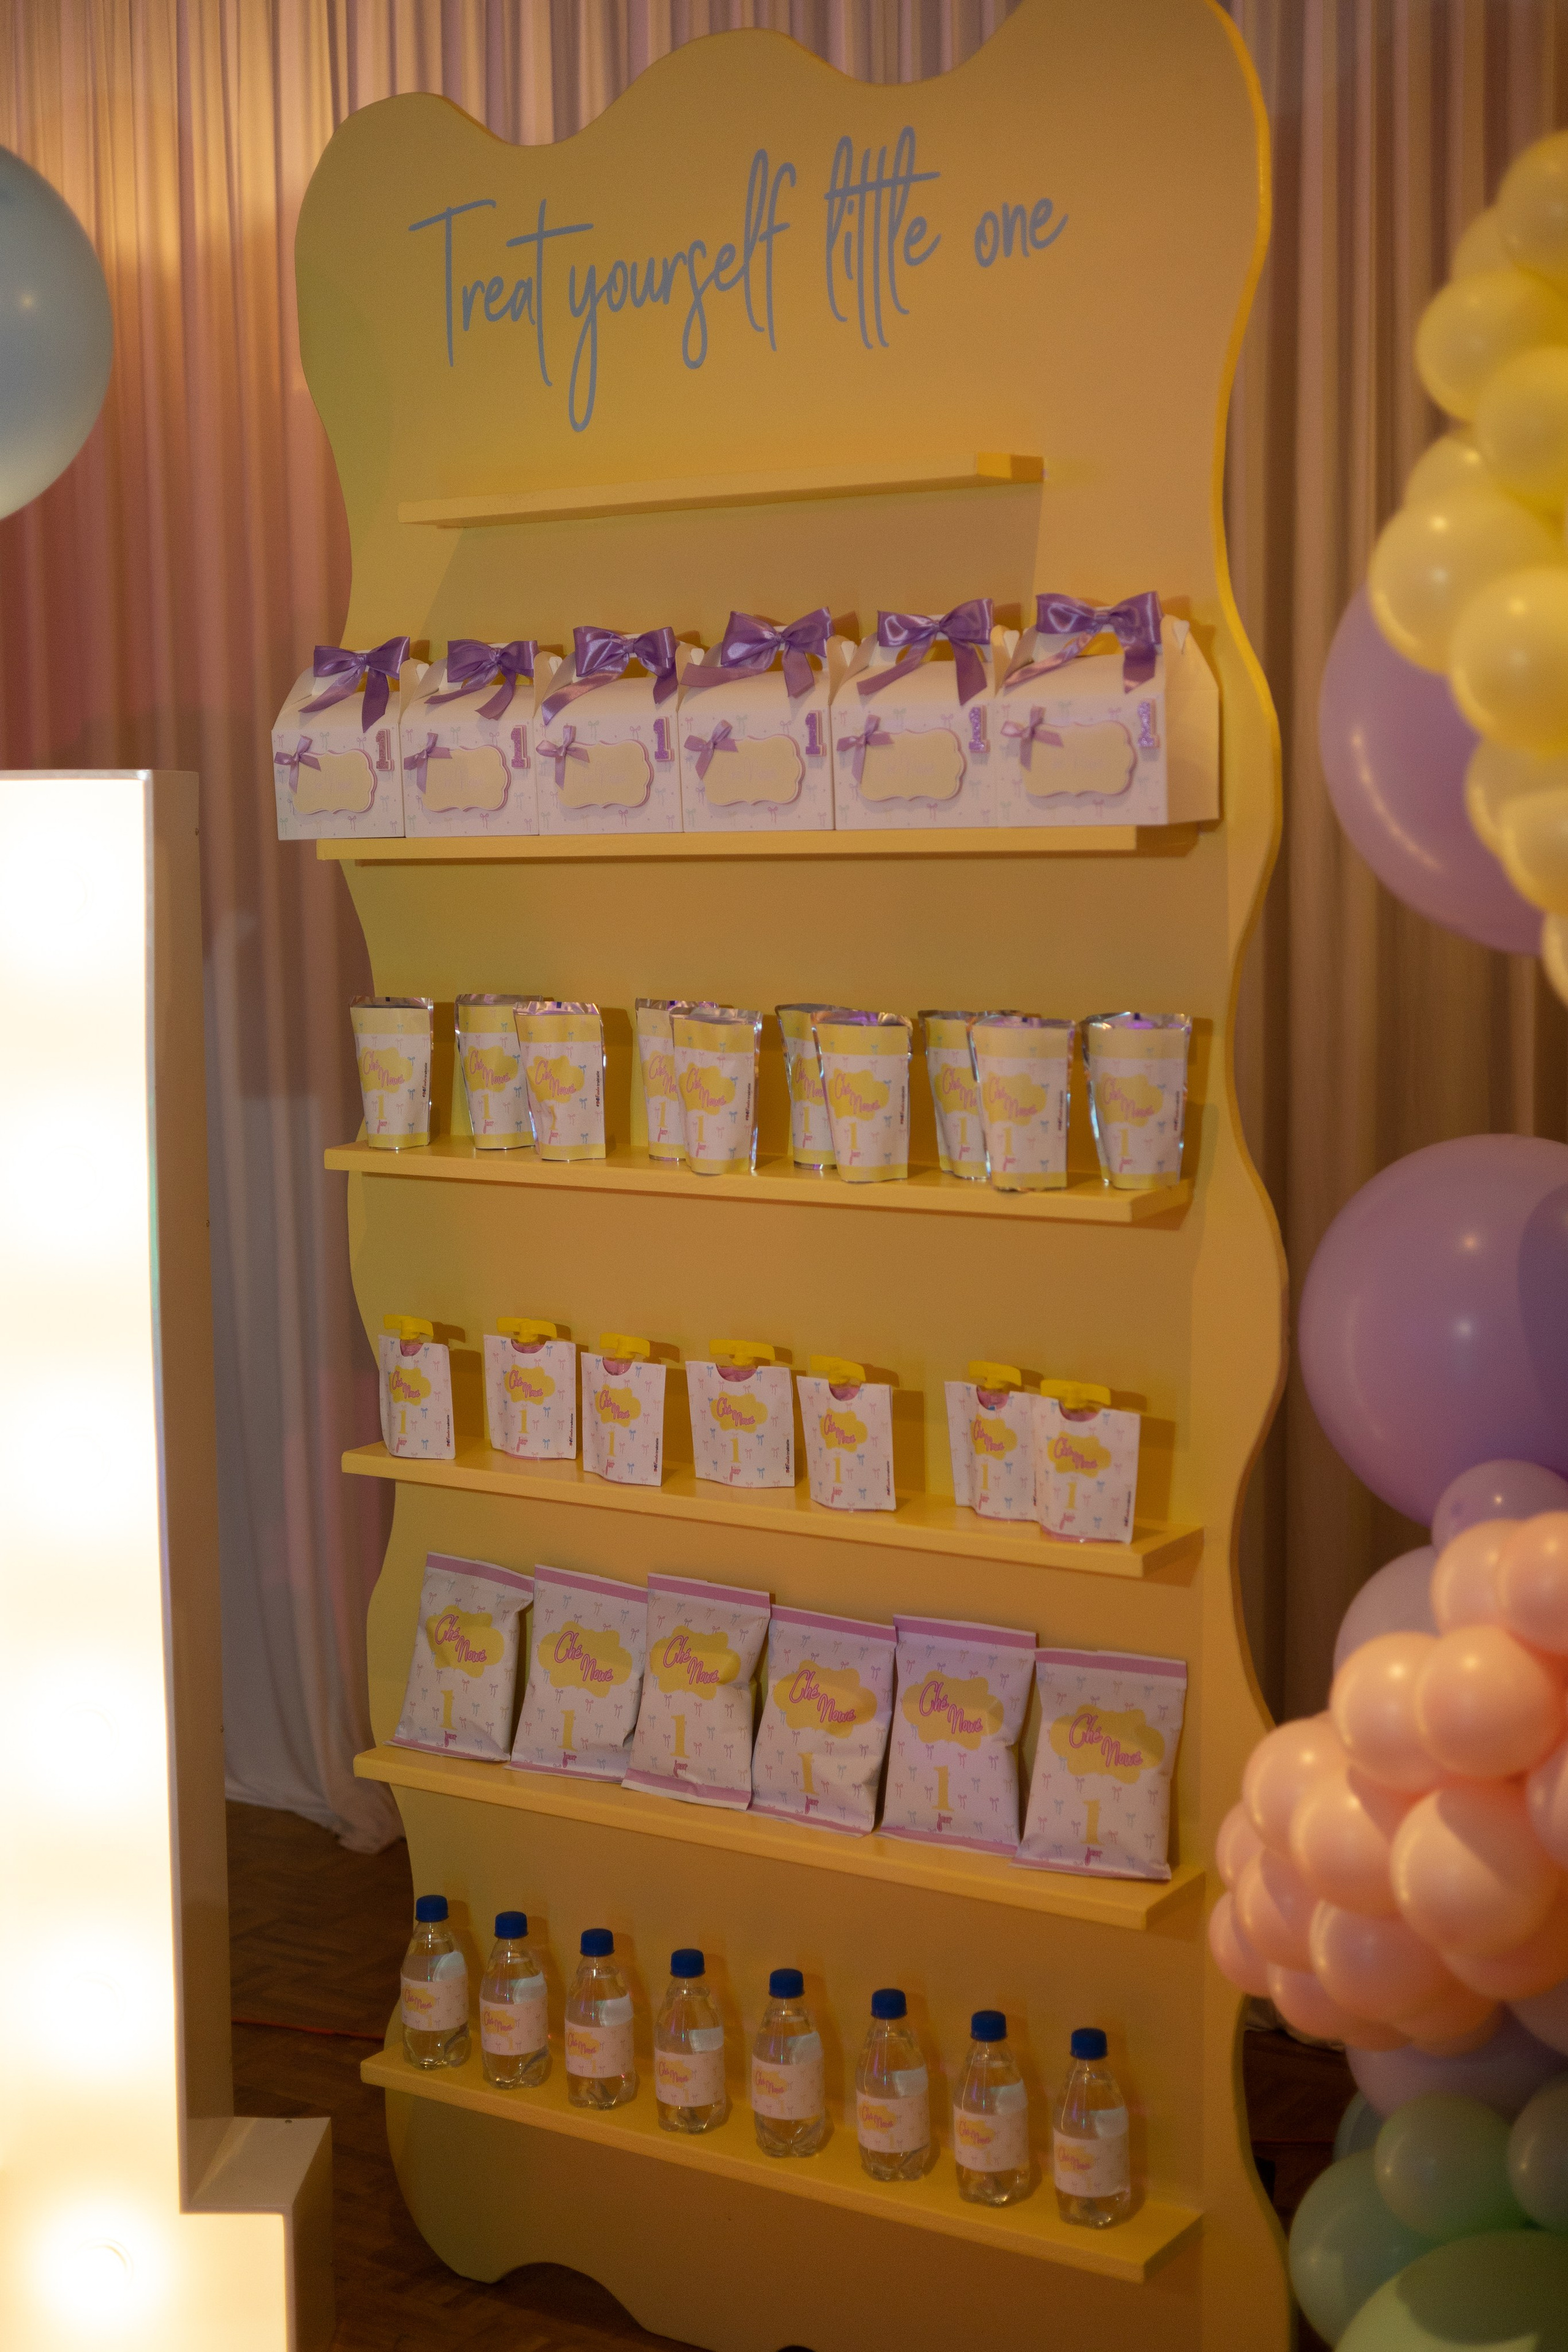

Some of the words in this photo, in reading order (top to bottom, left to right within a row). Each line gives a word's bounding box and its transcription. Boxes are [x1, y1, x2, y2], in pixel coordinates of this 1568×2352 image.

[408, 198, 594, 386] Treat
[568, 148, 797, 432] yourself
[824, 126, 942, 350] little
[974, 198, 1069, 268] one
[654, 717, 674, 761] 1
[805, 710, 826, 755] 1
[969, 704, 990, 753] 1
[1137, 699, 1159, 748] 1
[375, 729, 394, 770] 1
[511, 725, 530, 768] 1
[435, 1614, 459, 1645] Ché
[554, 1630, 583, 1663] Ché
[455, 1637, 487, 1663] Nowé
[580, 1654, 614, 1682] Nowé
[663, 1635, 692, 1668] Ché
[687, 1657, 719, 1684] Nowé
[789, 1670, 820, 1703] Ché
[439, 1690, 458, 1730] 1
[817, 1694, 856, 1723] Nowé
[919, 1681, 949, 1716] Ché
[557, 1709, 578, 1752] 1
[670, 1714, 690, 1758] 1
[947, 1704, 983, 1734] Nowé
[1069, 1713, 1103, 1749] Ché
[1101, 1736, 1144, 1768] Nowé
[797, 1752, 820, 1795] 1
[932, 1765, 954, 1812] 1
[1079, 1799, 1102, 1845] 1
